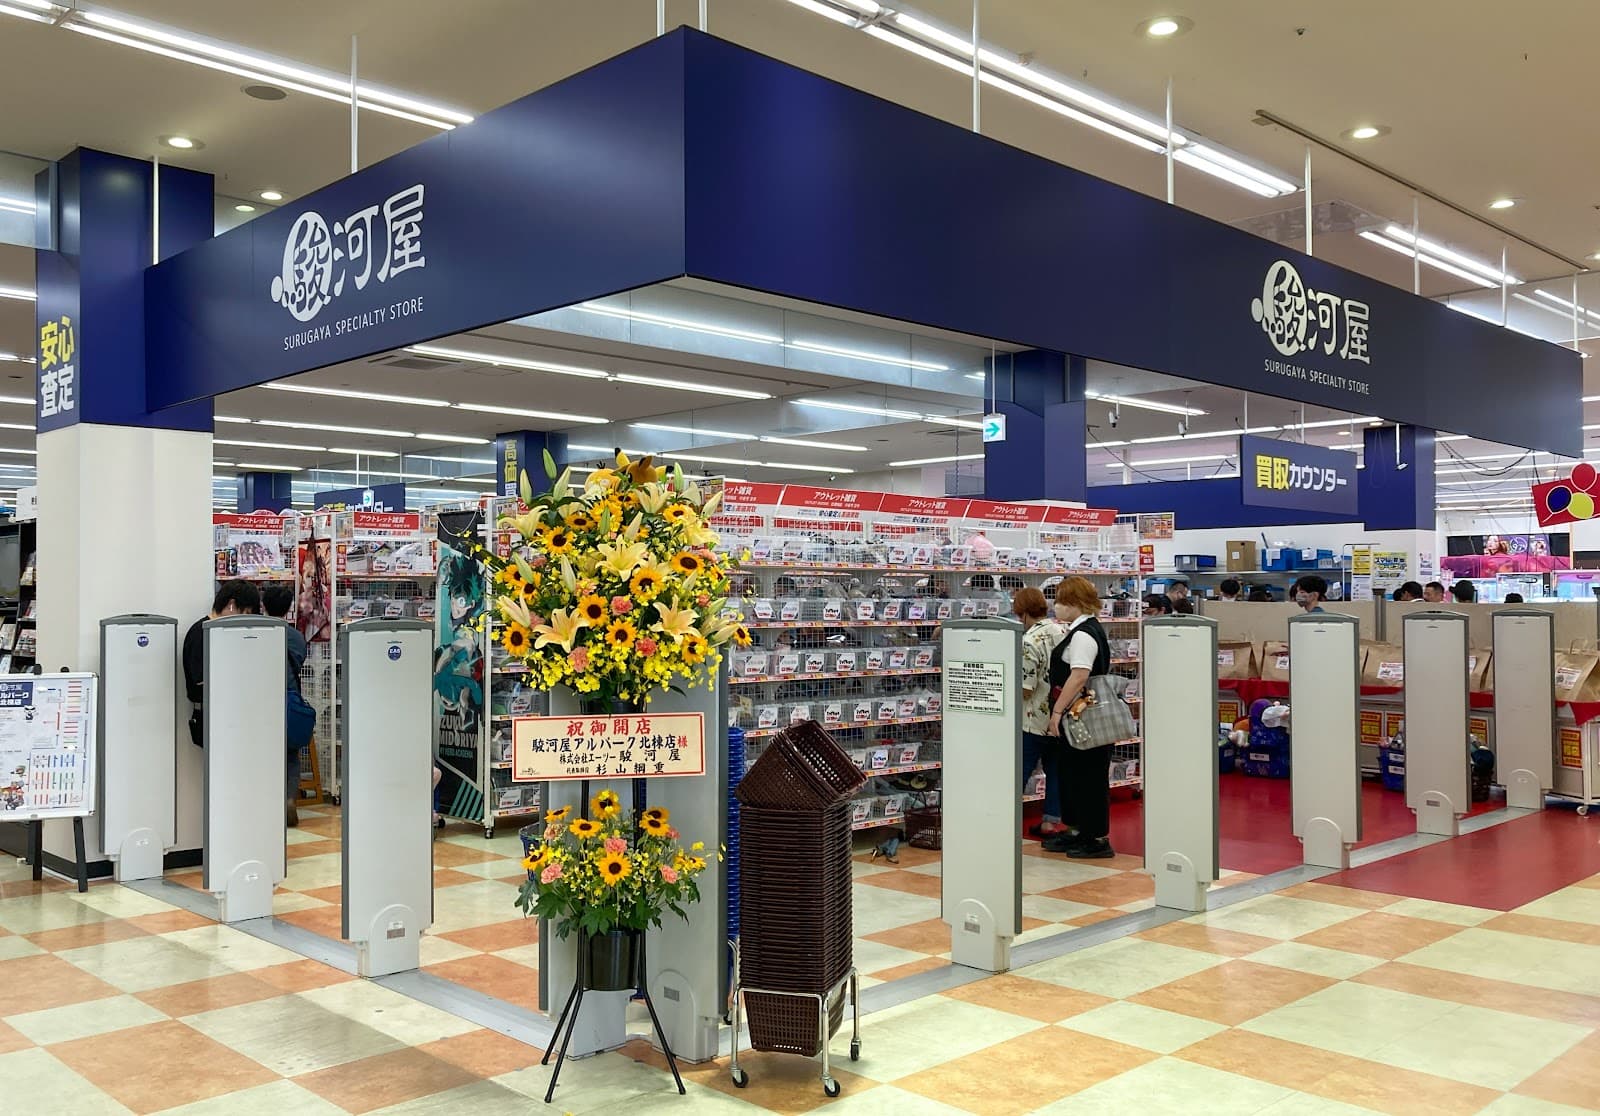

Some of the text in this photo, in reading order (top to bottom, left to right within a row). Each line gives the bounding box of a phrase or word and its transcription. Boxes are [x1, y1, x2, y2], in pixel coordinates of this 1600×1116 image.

[271, 184, 426, 322] 駿河屋
[284, 296, 424, 351] SURUGAYA SPECIALTY STORE
[1251, 260, 1371, 365] 駿河屋
[41, 315, 75, 371] 安心
[40, 364, 75, 418] 査定
[1264, 358, 1369, 395] SURUGAYA SPECIALTY STORE
[1256, 455, 1347, 492] 買取カウンター
[813, 491, 858, 503] アウトレット雑貨
[908, 499, 947, 509] アウトレット雑貨
[359, 514, 406, 524] アウトレット雑貨
[566, 719, 652, 737] 祝御開店
[619, 748, 681, 763] 駿河屋
